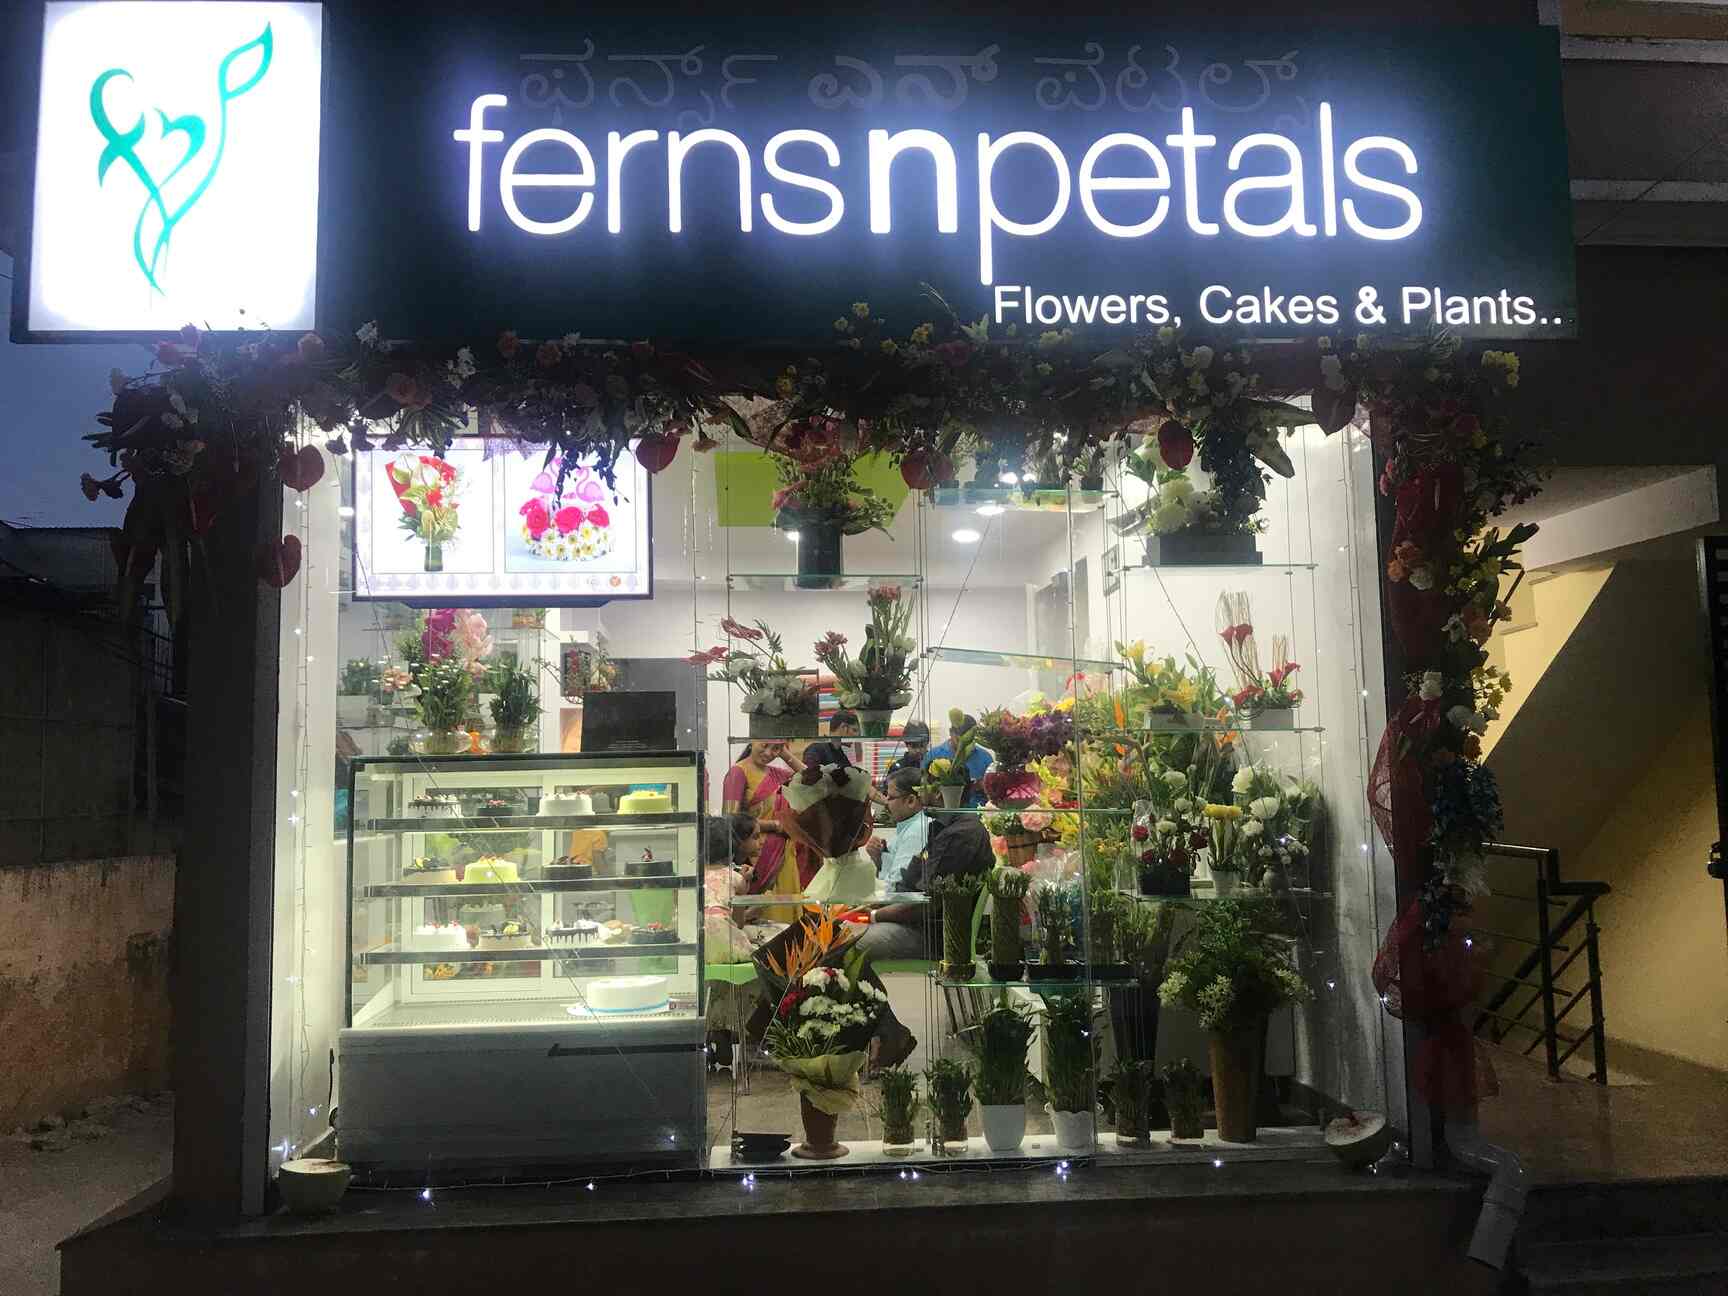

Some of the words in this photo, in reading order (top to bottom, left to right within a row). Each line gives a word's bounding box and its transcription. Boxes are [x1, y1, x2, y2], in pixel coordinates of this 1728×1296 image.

[994, 285, 1182, 332] Flowers,
[1199, 285, 1340, 325] Cakes
[1354, 285, 1387, 325] &
